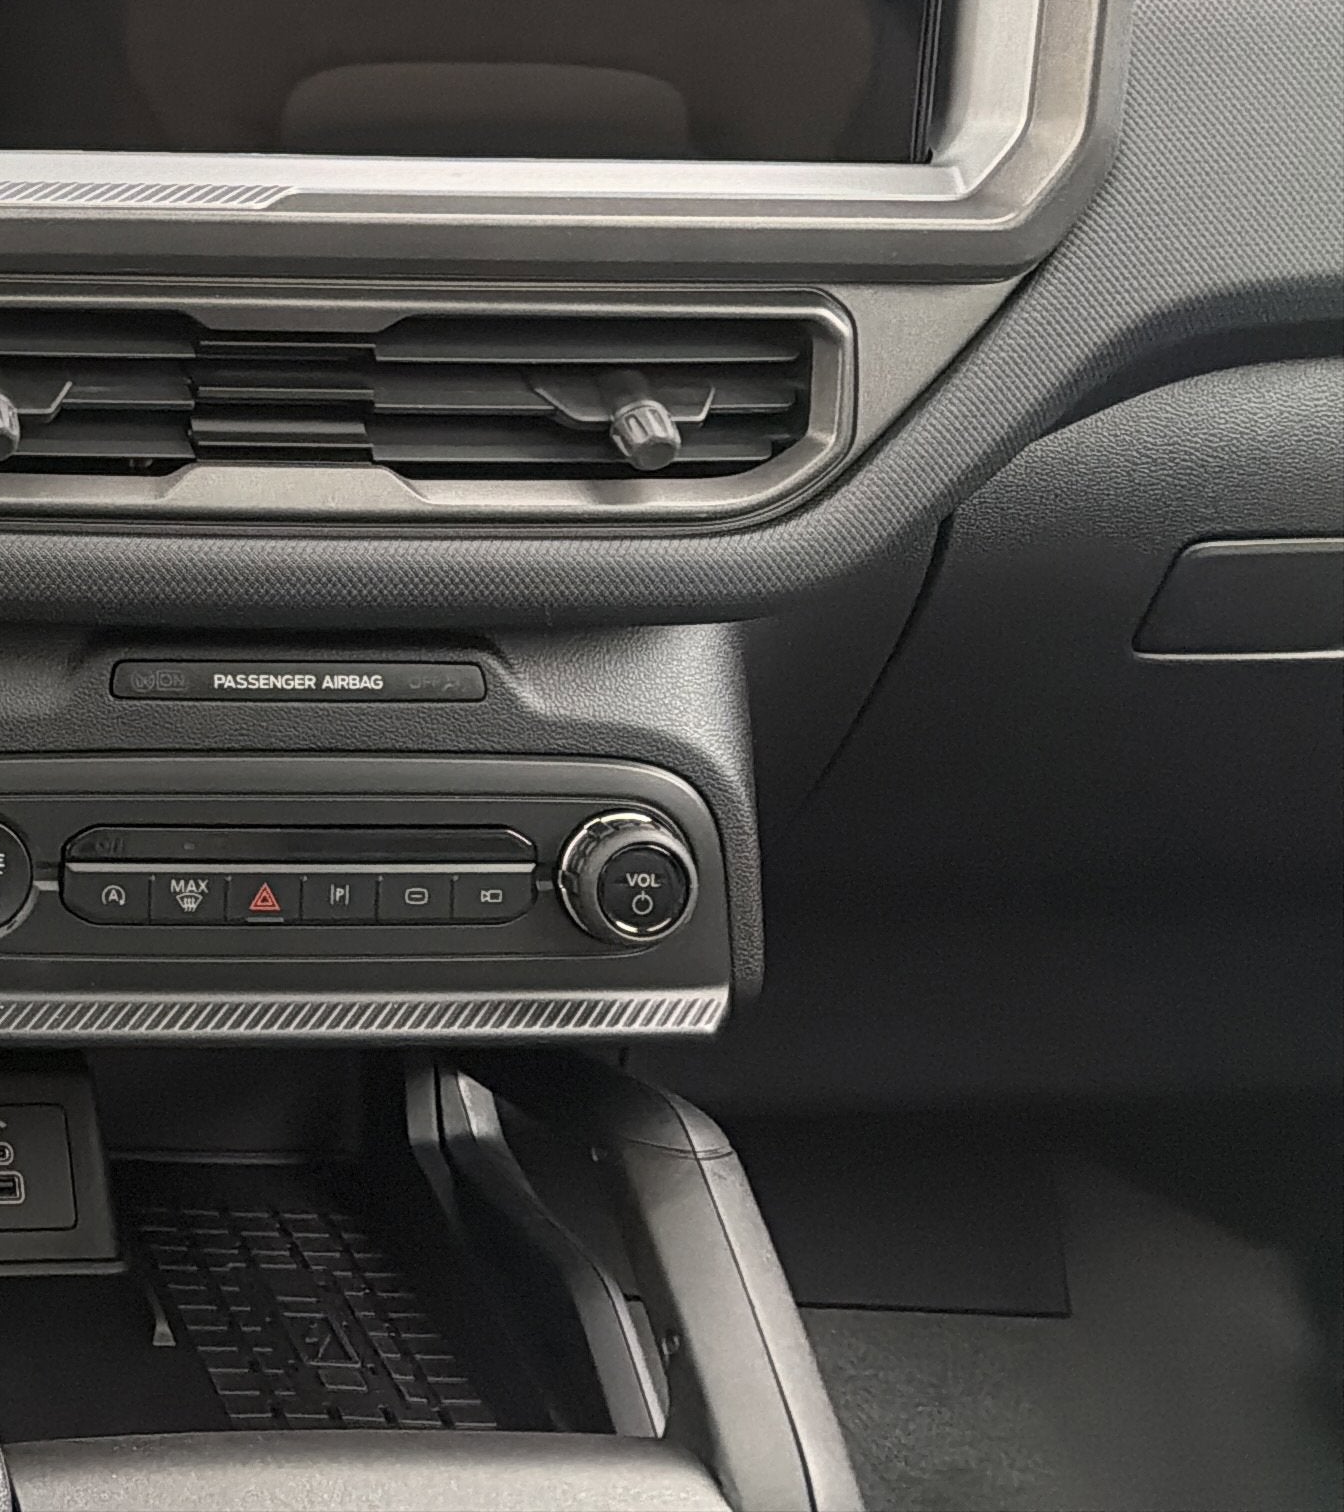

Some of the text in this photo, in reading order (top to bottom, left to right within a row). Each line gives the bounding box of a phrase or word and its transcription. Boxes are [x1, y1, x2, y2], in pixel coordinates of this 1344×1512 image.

[213, 673, 384, 690] PASSENGER AIRBAG
[170, 879, 209, 893] MAX
[625, 872, 662, 888] VOL
